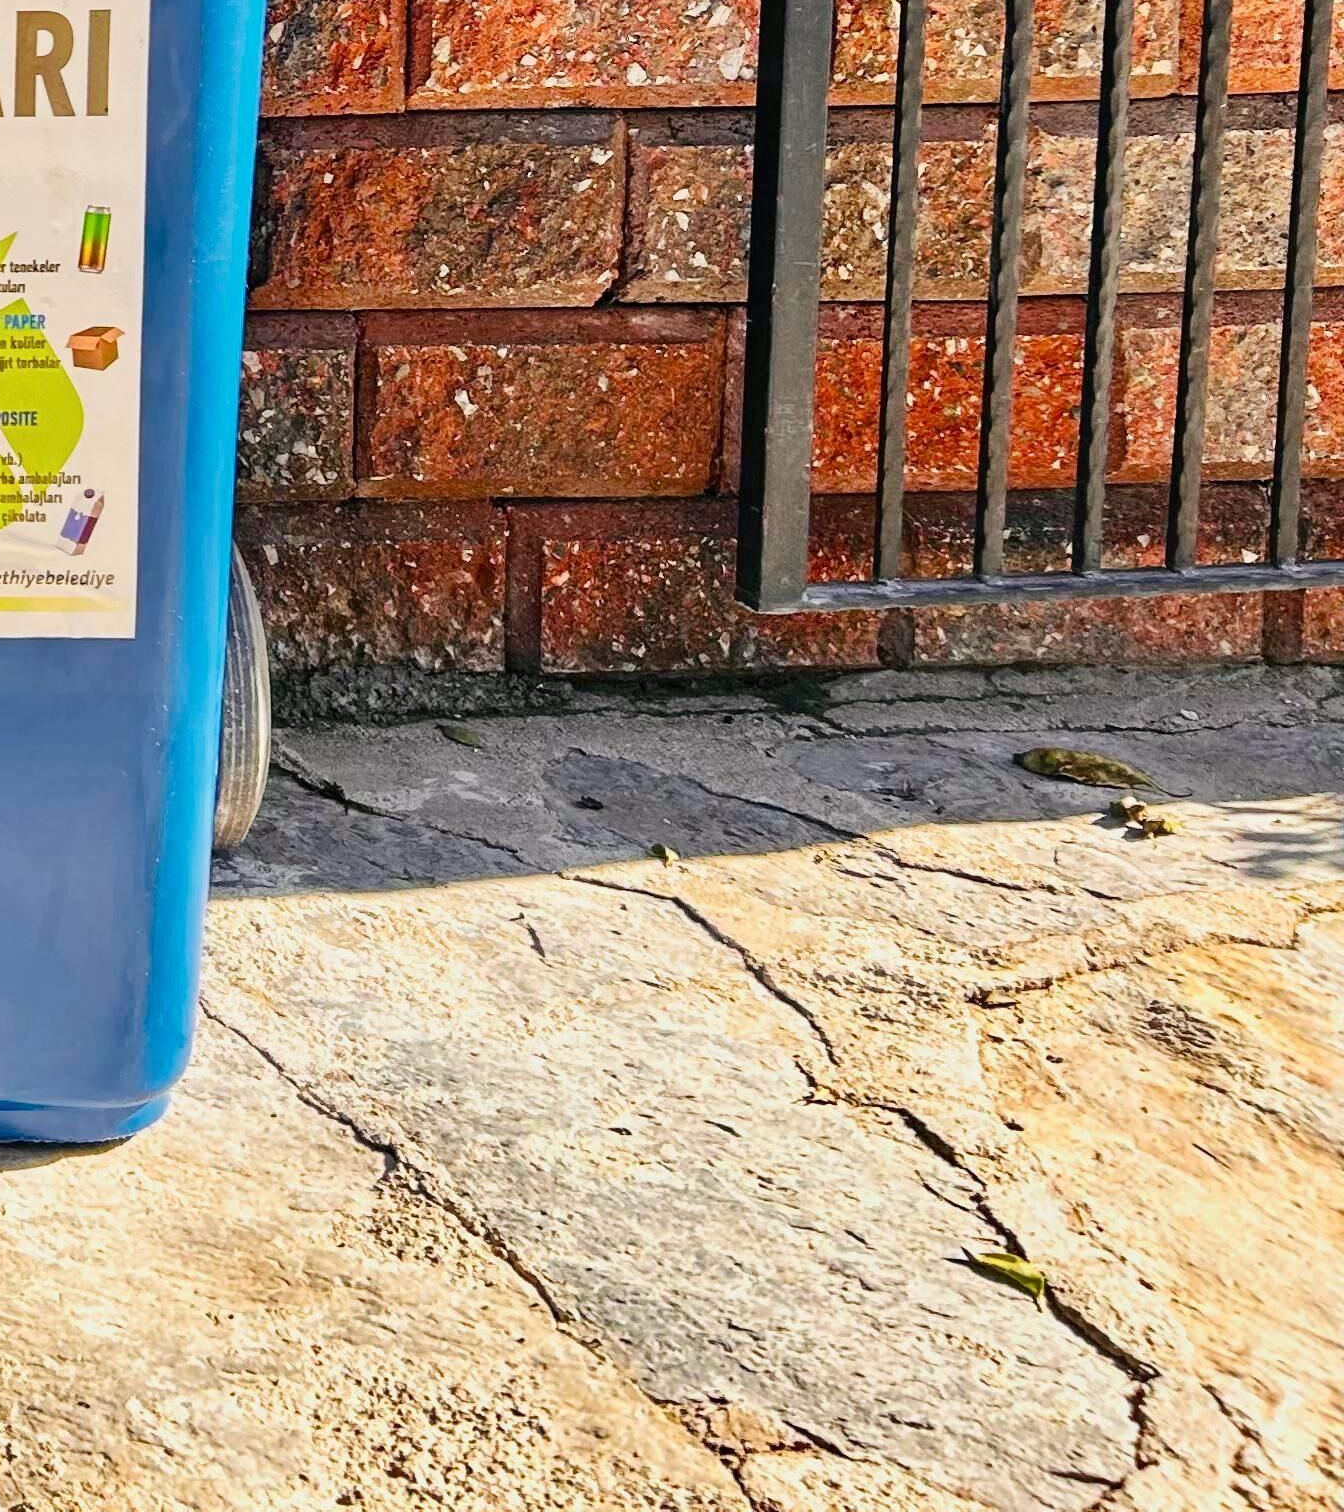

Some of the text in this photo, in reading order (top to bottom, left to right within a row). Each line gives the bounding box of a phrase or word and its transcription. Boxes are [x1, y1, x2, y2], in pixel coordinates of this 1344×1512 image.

[10, 260, 60, 272] tenekeler
[5, 315, 45, 329] PAPER
[17, 356, 61, 368] torbalar
[19, 472, 80, 487] ambalajları
[0, 491, 62, 506] ambalajları
[2, 510, 46, 525] çikolata
